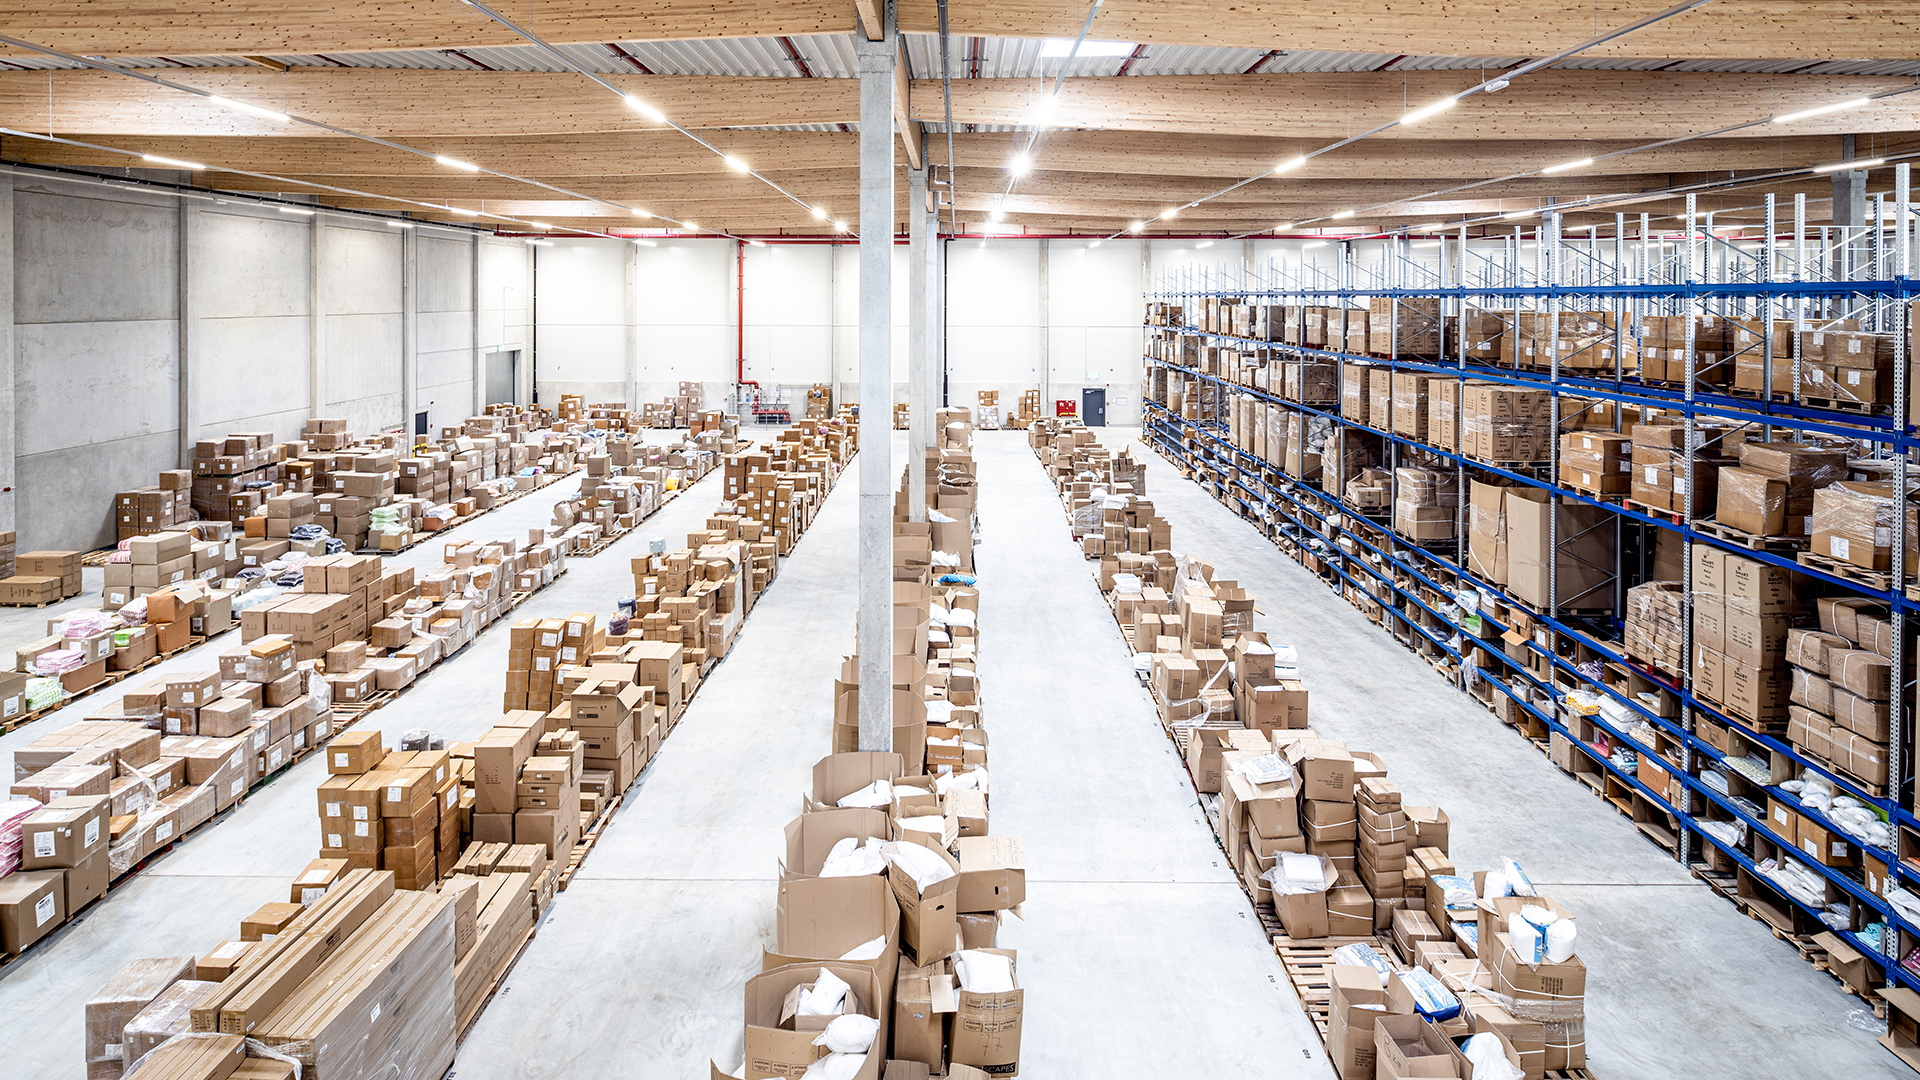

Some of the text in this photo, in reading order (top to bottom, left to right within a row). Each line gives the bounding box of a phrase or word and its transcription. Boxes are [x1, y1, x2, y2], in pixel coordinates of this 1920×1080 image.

[1701, 558, 1714, 566] SMART
[1734, 670, 1748, 679] SMART
[984, 1063, 1014, 1073] SCAPES
